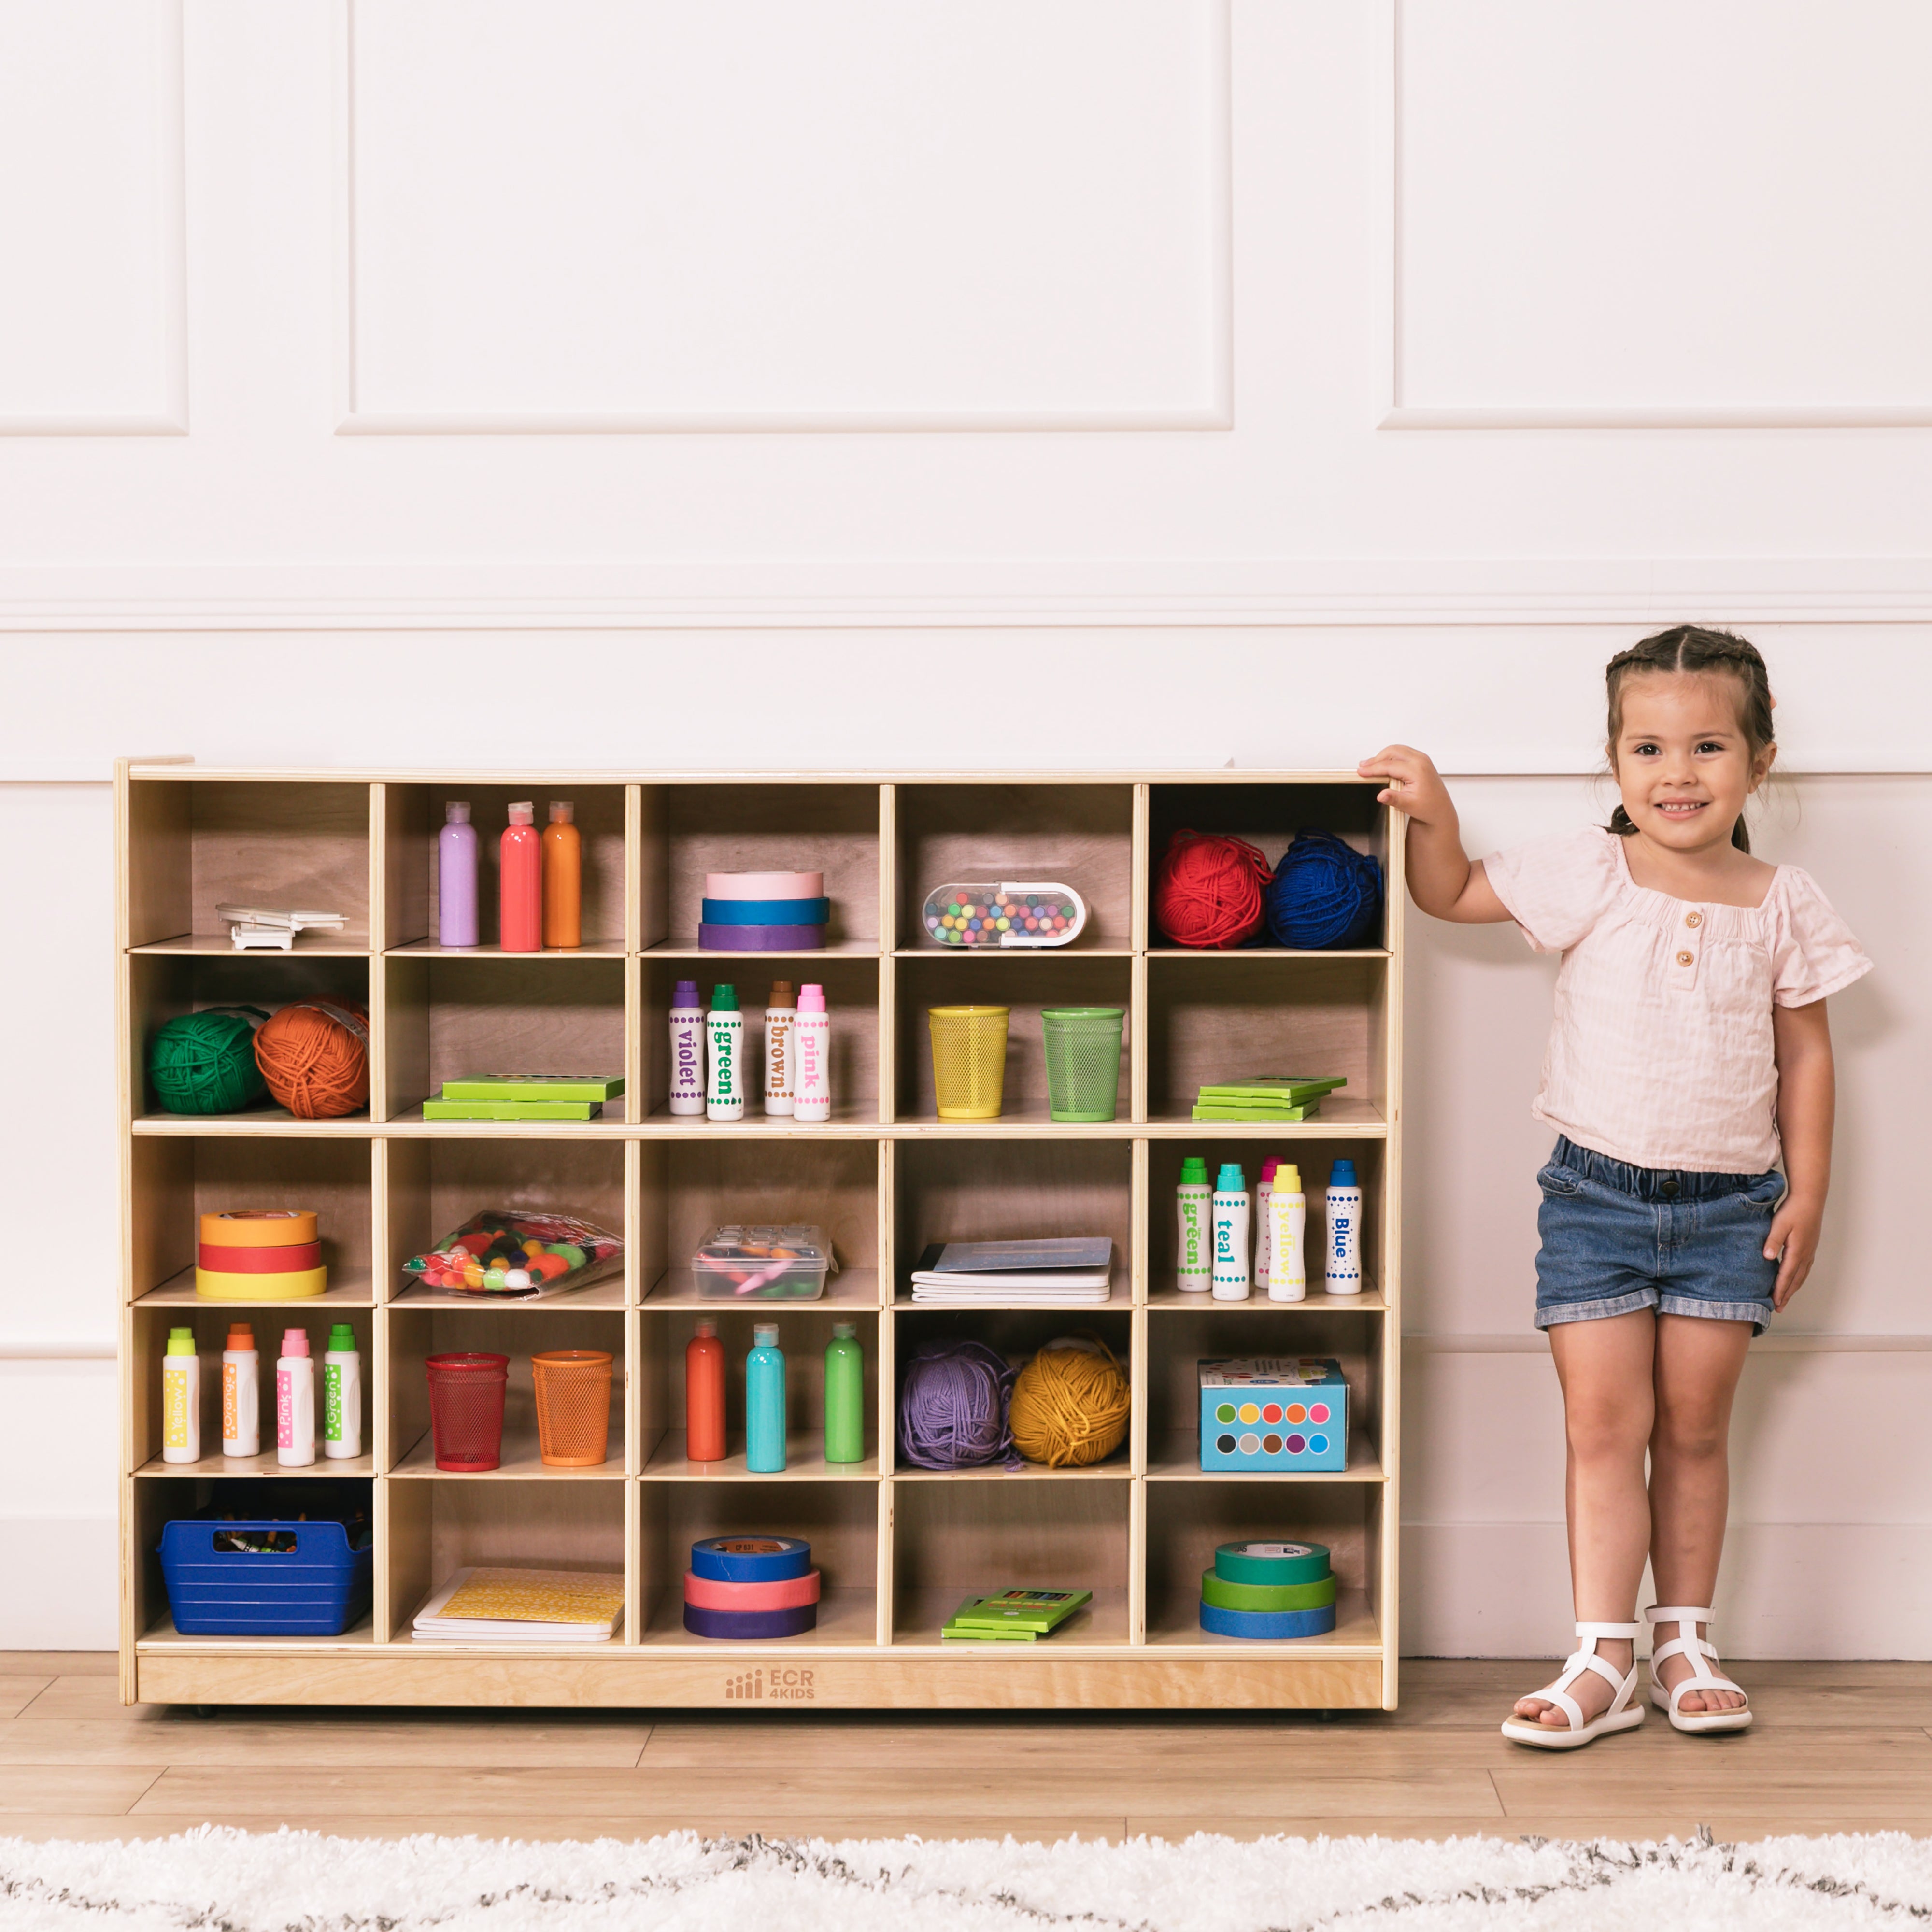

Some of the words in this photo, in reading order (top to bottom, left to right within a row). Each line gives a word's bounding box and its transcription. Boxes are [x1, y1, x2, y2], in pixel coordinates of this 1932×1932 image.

[678, 1029, 697, 1086] violet
[713, 1031, 733, 1095] green
[771, 1025, 789, 1088] brown
[801, 1035, 820, 1089] pink
[1182, 1202, 1199, 1265] green
[1217, 1220, 1235, 1263] teal
[1278, 1211, 1292, 1276] yellow
[1335, 1218, 1350, 1258] Blue
[171, 1387, 183, 1430] Yellow
[224, 1376, 235, 1427] Orange
[280, 1394, 290, 1425] Pink
[327, 1381, 337, 1423] Green
[769, 1688, 815, 1699] 4KIDS
[770, 1669, 814, 1686] ECR
